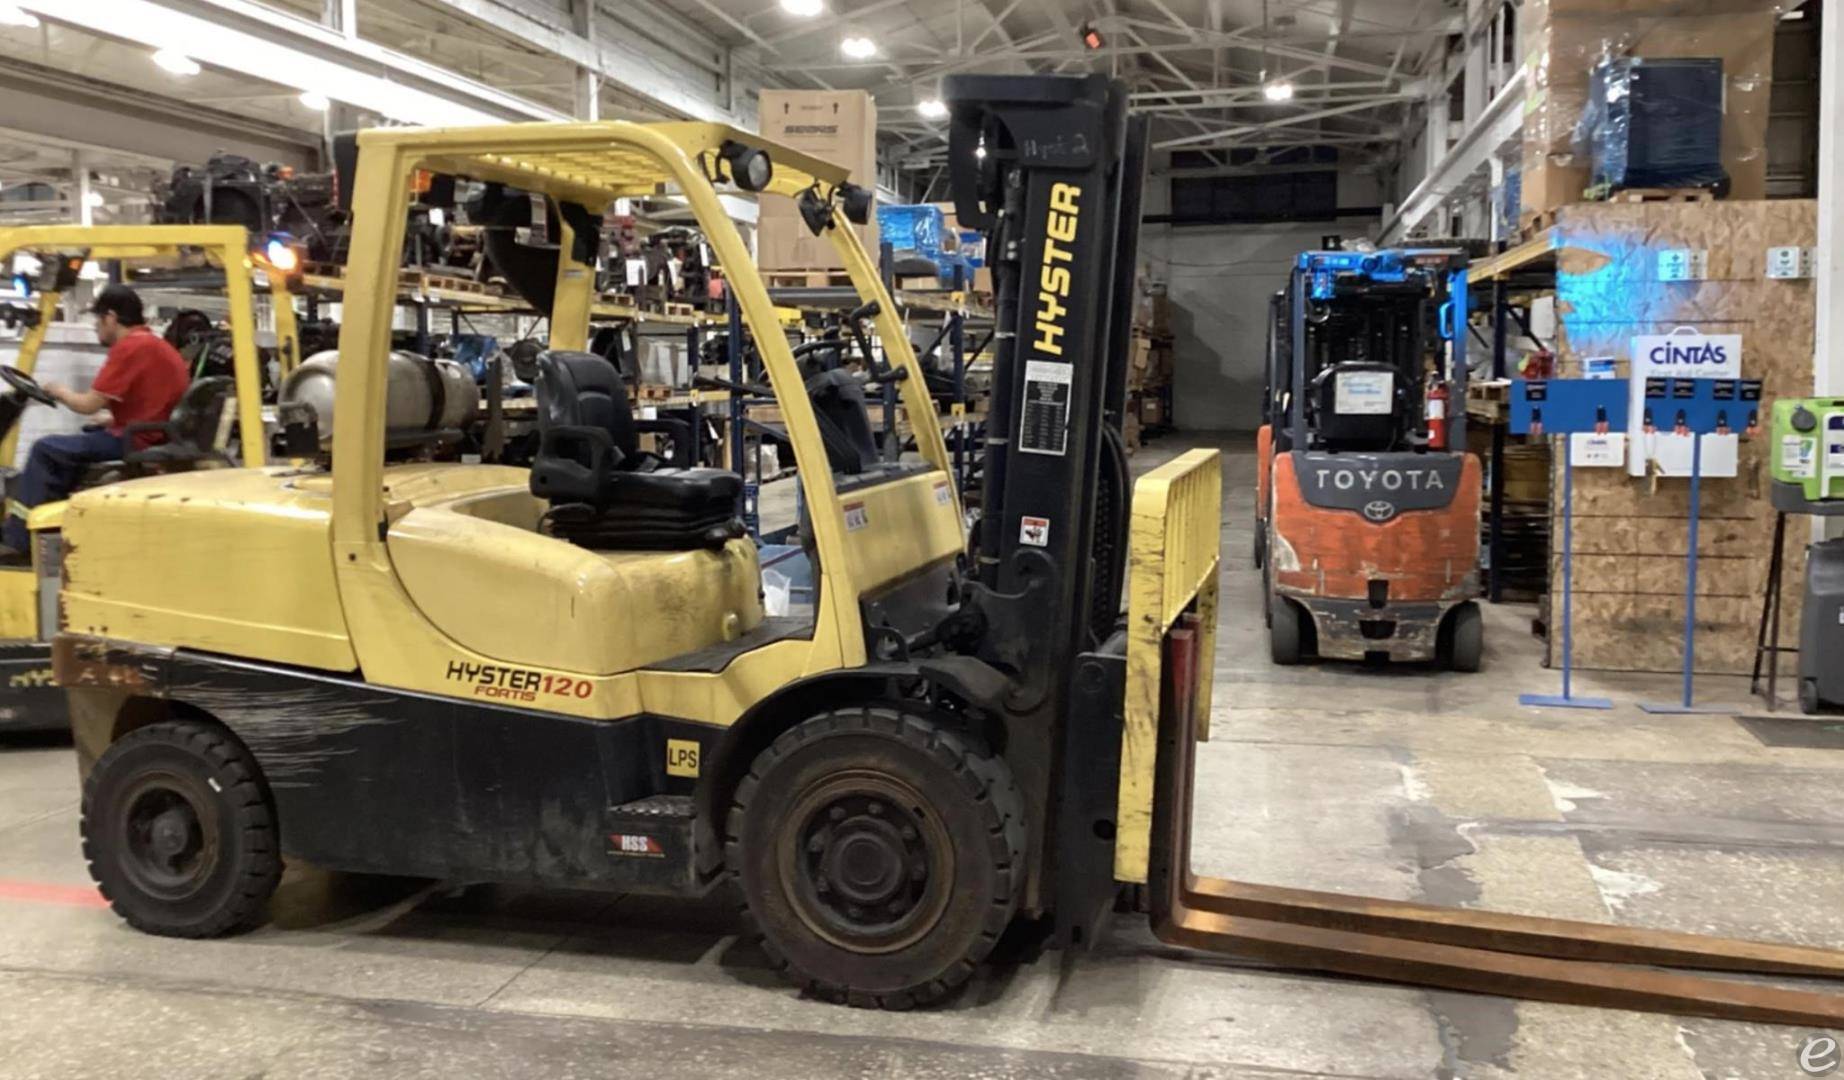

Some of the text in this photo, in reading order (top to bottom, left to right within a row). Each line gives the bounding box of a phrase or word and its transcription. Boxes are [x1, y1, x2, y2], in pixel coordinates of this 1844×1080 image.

[1033, 182, 1082, 356] HYSTER
[1316, 469, 1444, 490] TOYOTA
[446, 660, 593, 699] HYSTER 120
[474, 685, 537, 702] FORTIS
[668, 747, 698, 768] LPS
[621, 834, 649, 852] HSS
